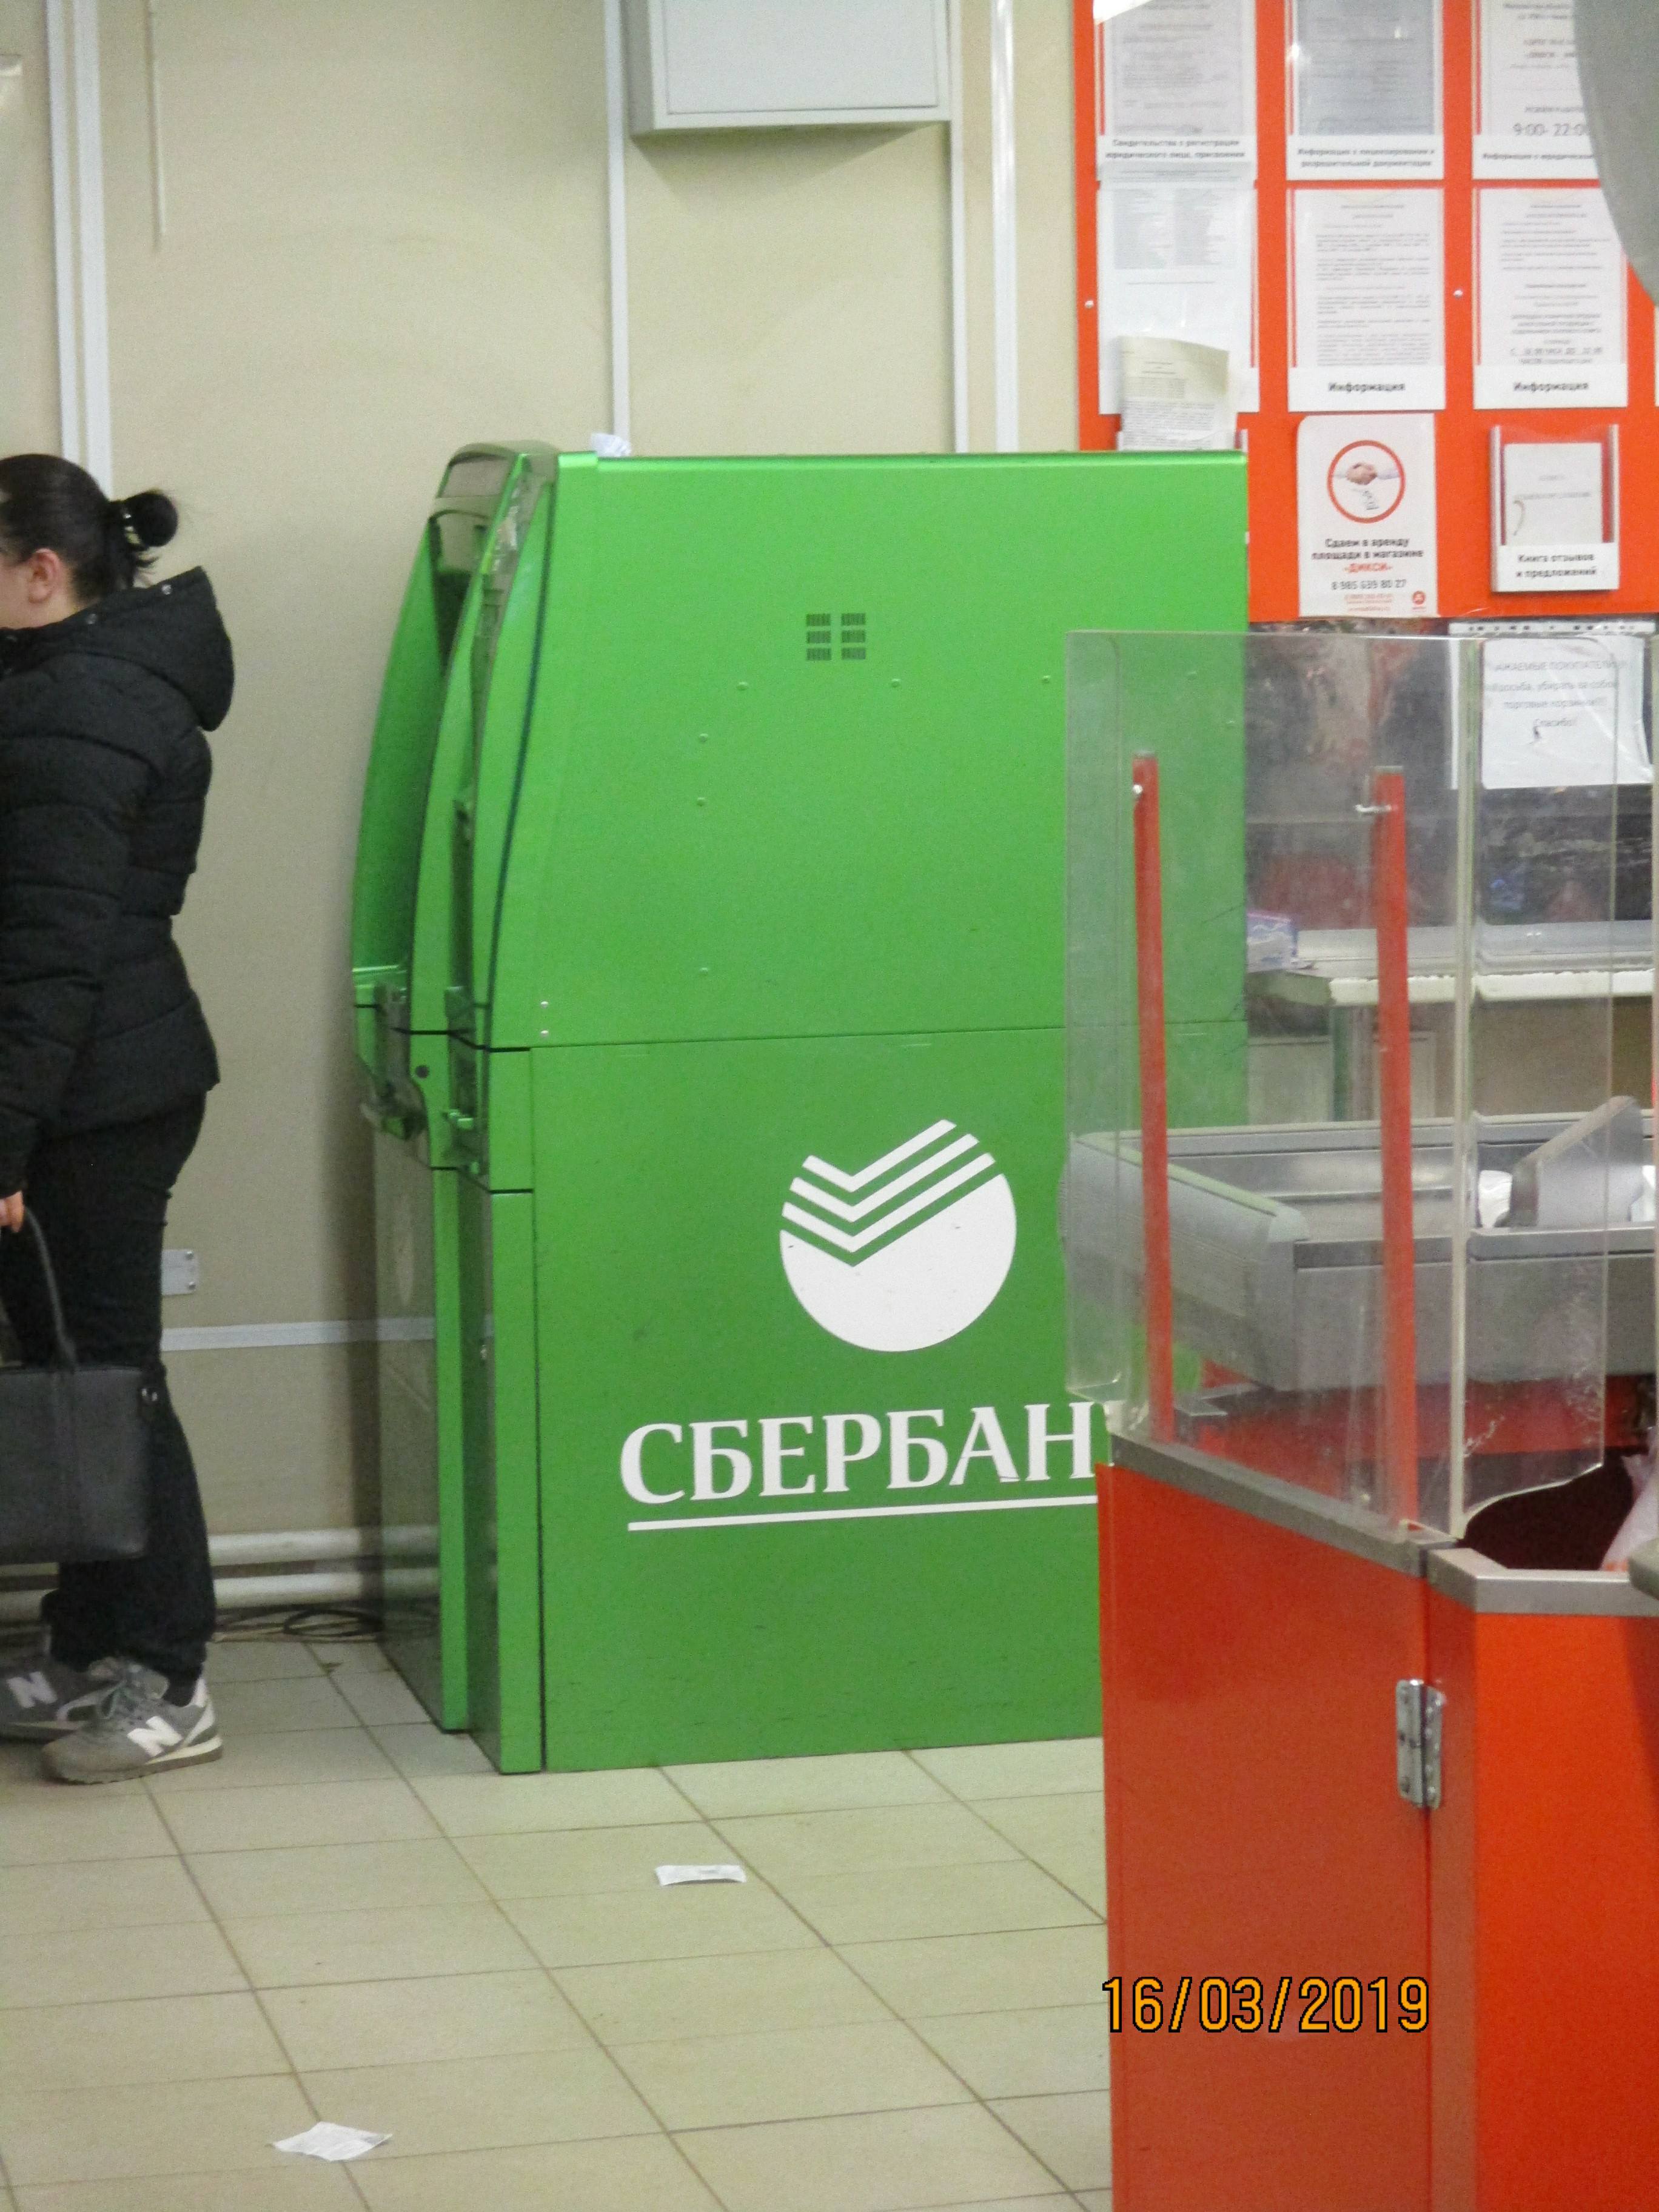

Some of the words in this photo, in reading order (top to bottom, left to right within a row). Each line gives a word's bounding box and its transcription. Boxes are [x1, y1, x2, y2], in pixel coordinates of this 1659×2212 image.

[1328, 381, 1406, 394] Информация
[1513, 381, 1589, 394] Информация
[1324, 538, 1360, 548] Сдаем
[1371, 538, 1410, 548] аренду
[1311, 552, 1362, 560] площади
[1372, 550, 1424, 559] магазине
[1518, 554, 1549, 563] Книга
[1550, 554, 1595, 562] отзывов
[1524, 566, 1598, 579] предложений
[620, 1401, 1098, 1504] СБЕРБАН
